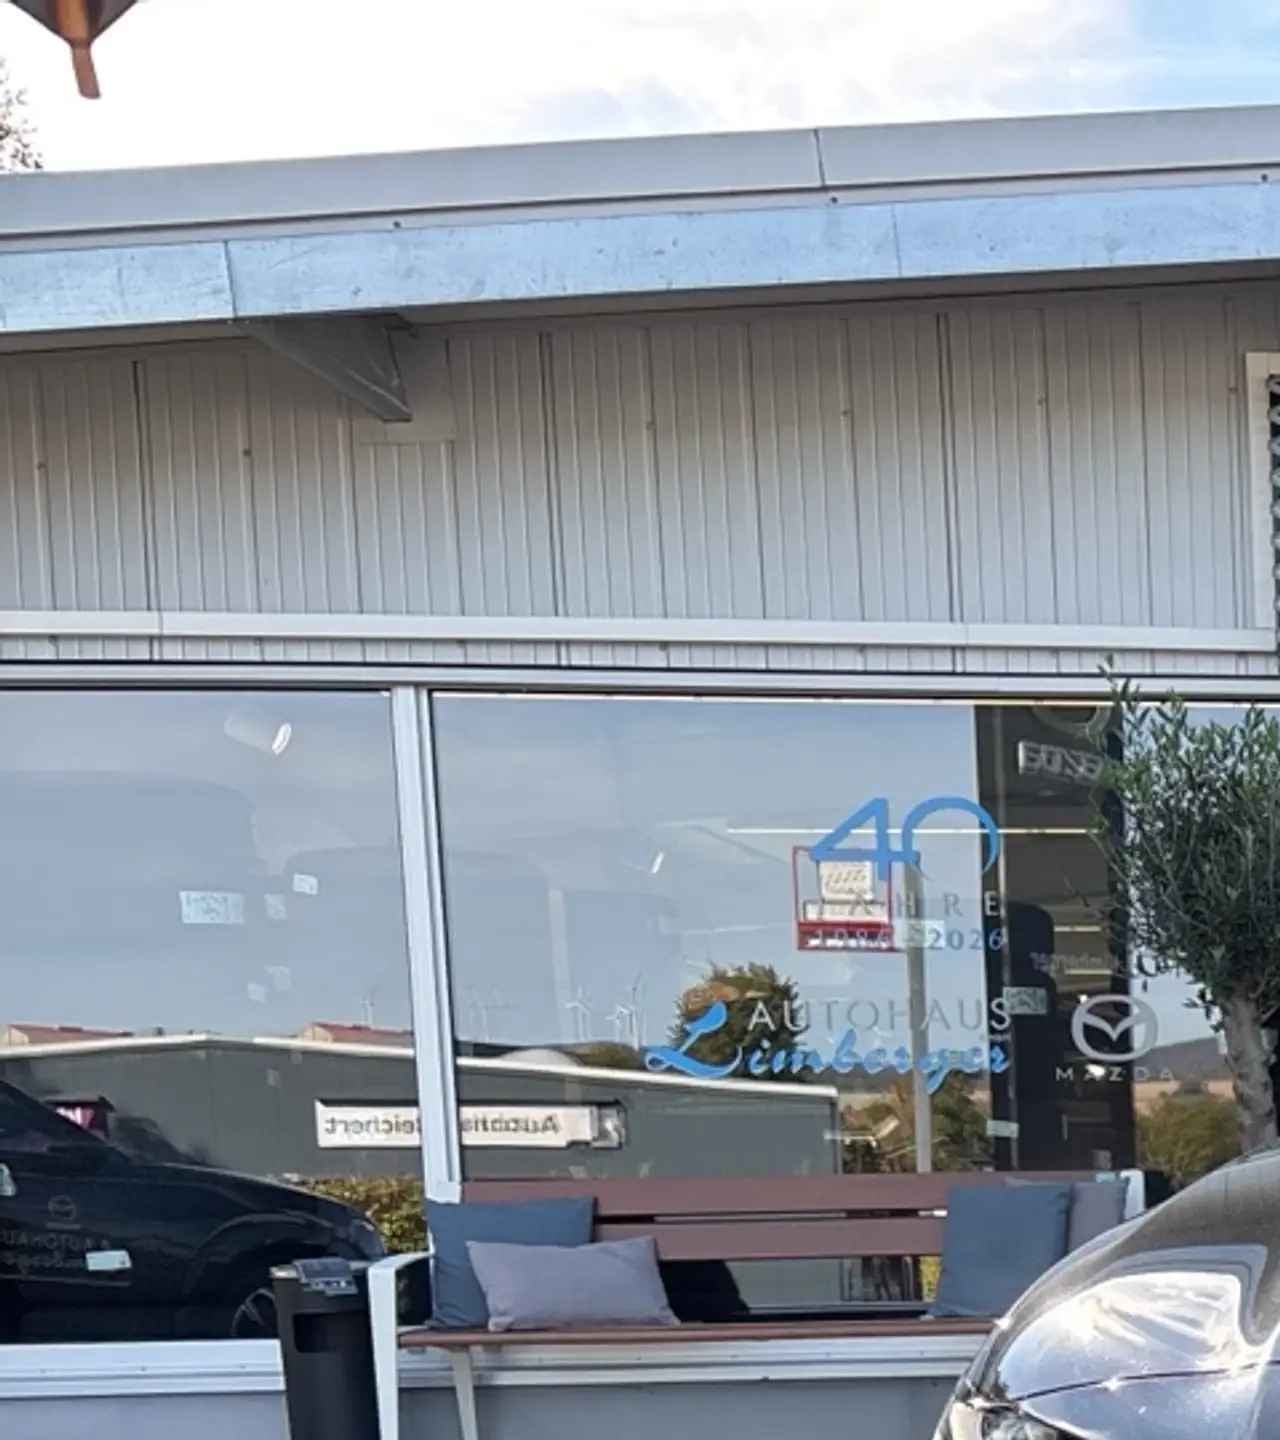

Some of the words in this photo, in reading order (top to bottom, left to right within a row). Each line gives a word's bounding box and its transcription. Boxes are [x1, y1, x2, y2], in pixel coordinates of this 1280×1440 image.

[808, 796, 999, 882] 40
[928, 929, 1005, 950] 2026
[746, 997, 1011, 1032] AUTOHAUS
[645, 1001, 1010, 1094] Limberger
[1055, 1066, 1175, 1082] MAZDA
